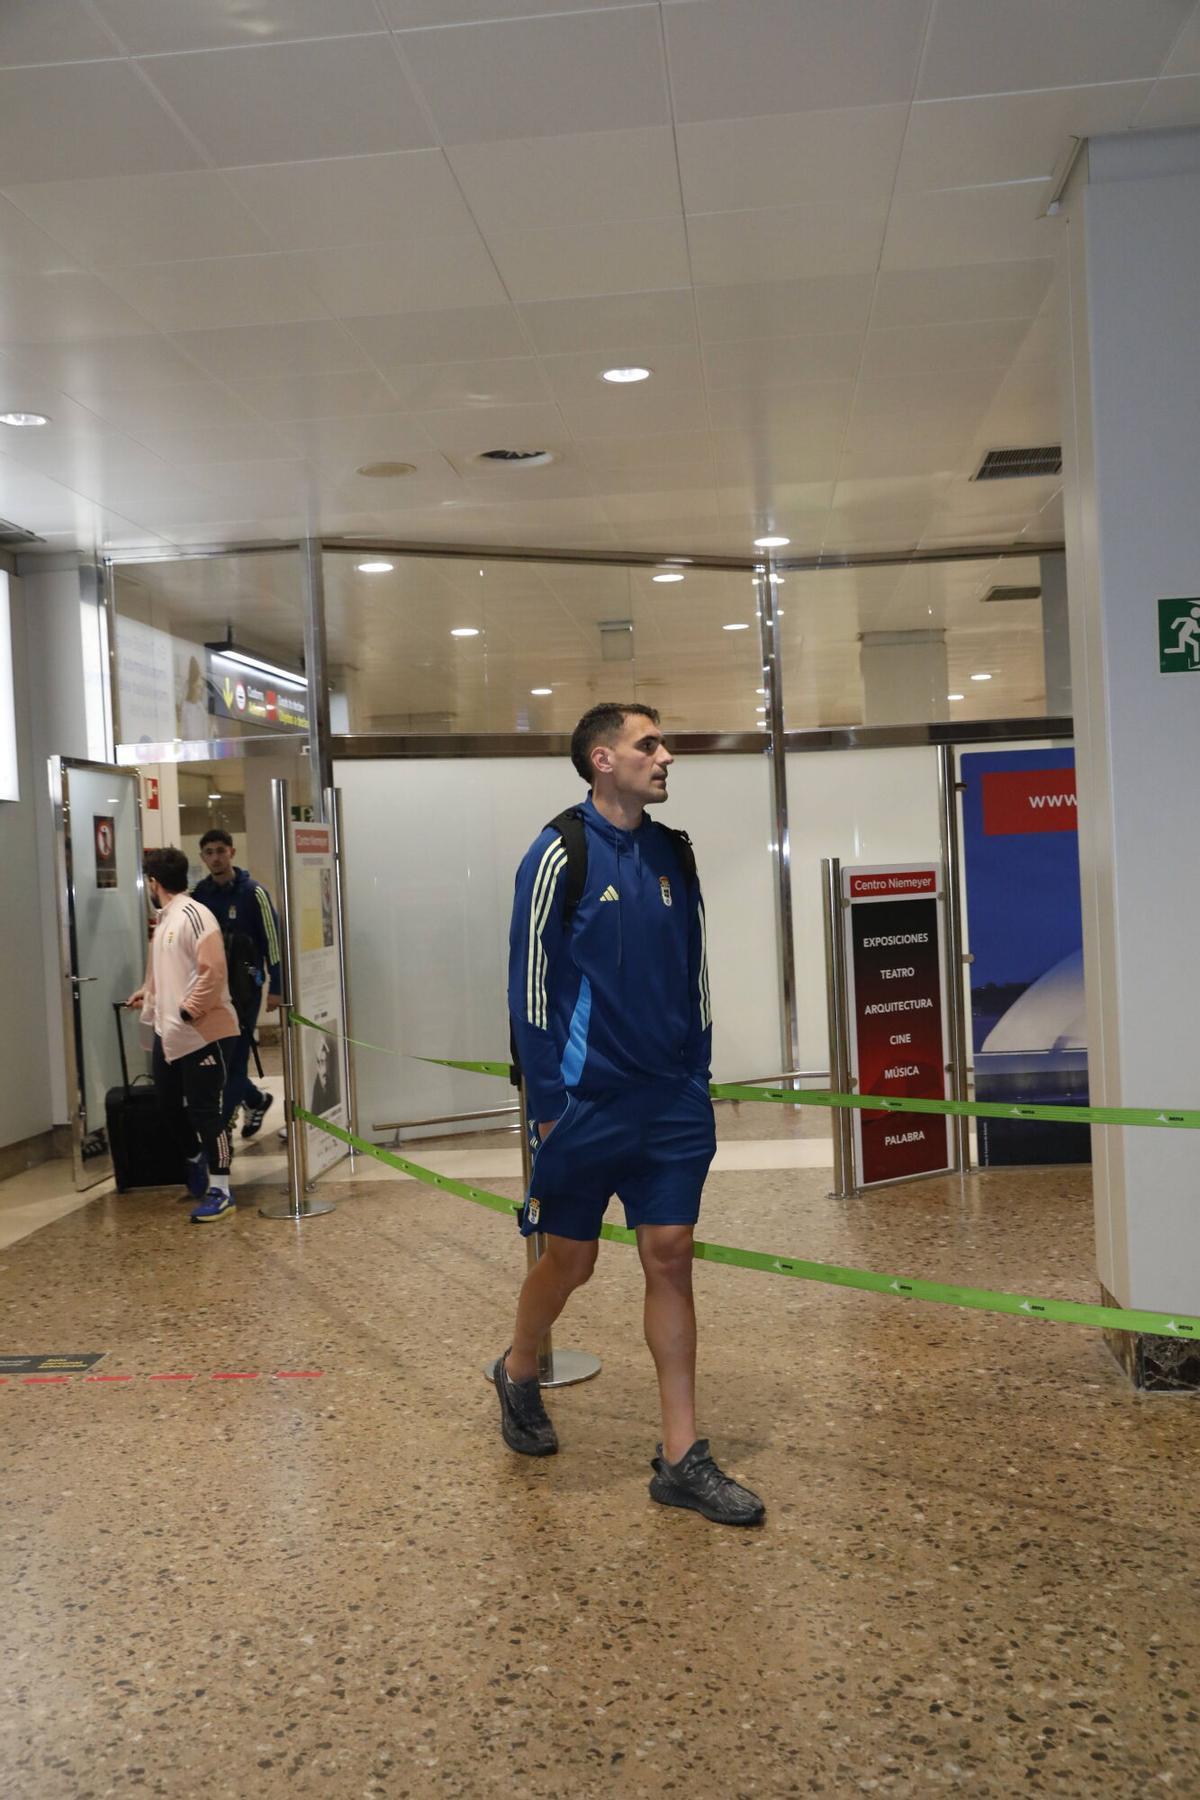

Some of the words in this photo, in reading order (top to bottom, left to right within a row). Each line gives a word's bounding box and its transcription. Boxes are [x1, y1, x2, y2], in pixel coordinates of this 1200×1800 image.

[854, 880, 887, 891] Centro
[888, 878, 932, 889] Niemeyer
[863, 933, 928, 948] EXPOSICIONES
[880, 967, 915, 979] TEATRO
[864, 999, 933, 1015] ARQUITECTURA
[889, 1034, 912, 1045] CINE
[884, 1066, 920, 1079] MÚSICA
[885, 1131, 925, 1146] PALABRA
